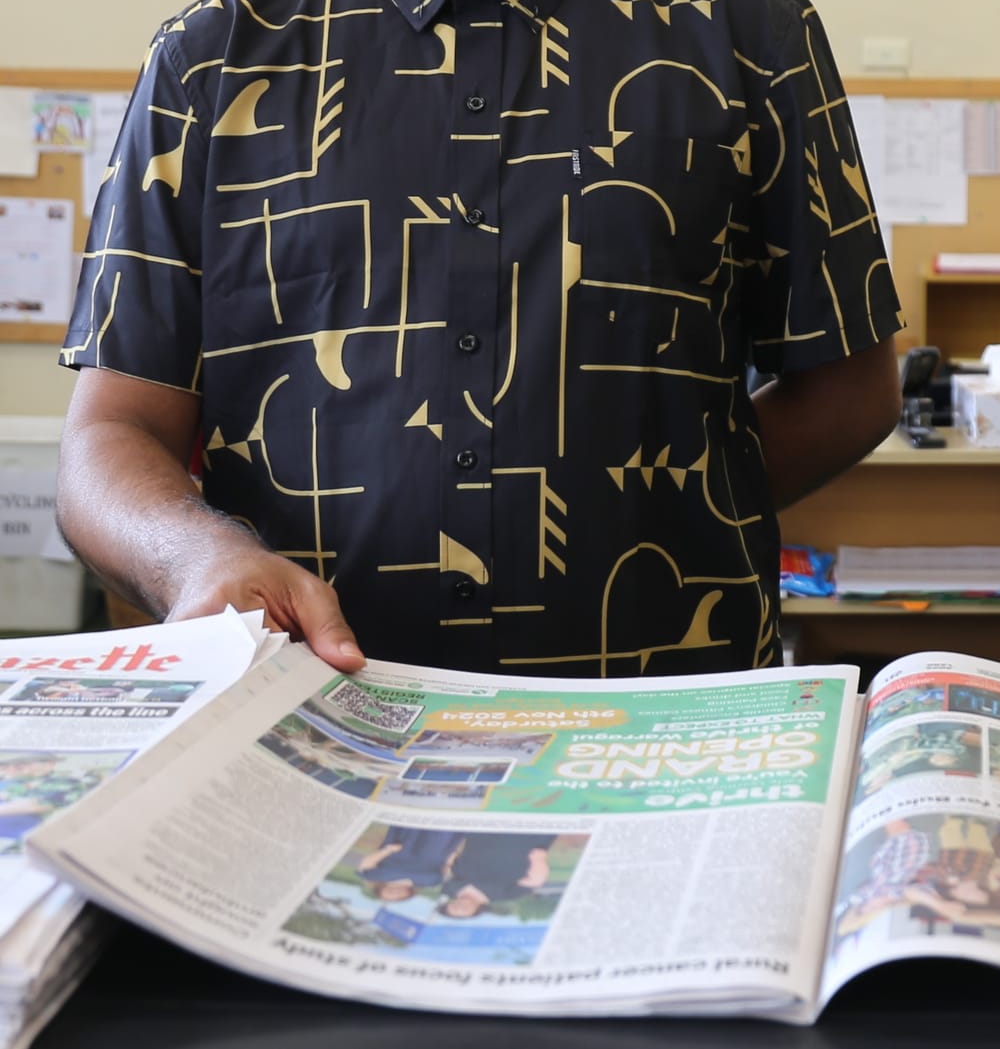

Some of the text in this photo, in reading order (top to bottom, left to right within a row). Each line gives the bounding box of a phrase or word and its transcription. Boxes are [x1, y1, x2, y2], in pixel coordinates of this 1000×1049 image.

[15, 705, 87, 716] across
[90, 705, 126, 716] the
[128, 706, 169, 717] line
[442, 710, 615, 720] 9th Nov 2024
[464, 720, 590, 728] Saturday,
[691, 724, 782, 738] thrive
[567, 730, 817, 757] OPENING
[572, 732, 682, 742] Warragul
[556, 748, 816, 779] GRAND
[547, 780, 589, 790] the
[598, 780, 623, 789] to
[630, 776, 720, 789] invited
[644, 783, 805, 808] thrive
[355, 960, 387, 974] of
[611, 960, 707, 978] cancer
[714, 958, 789, 976] Rural
[395, 965, 472, 988] focus
[481, 968, 602, 988] patients
